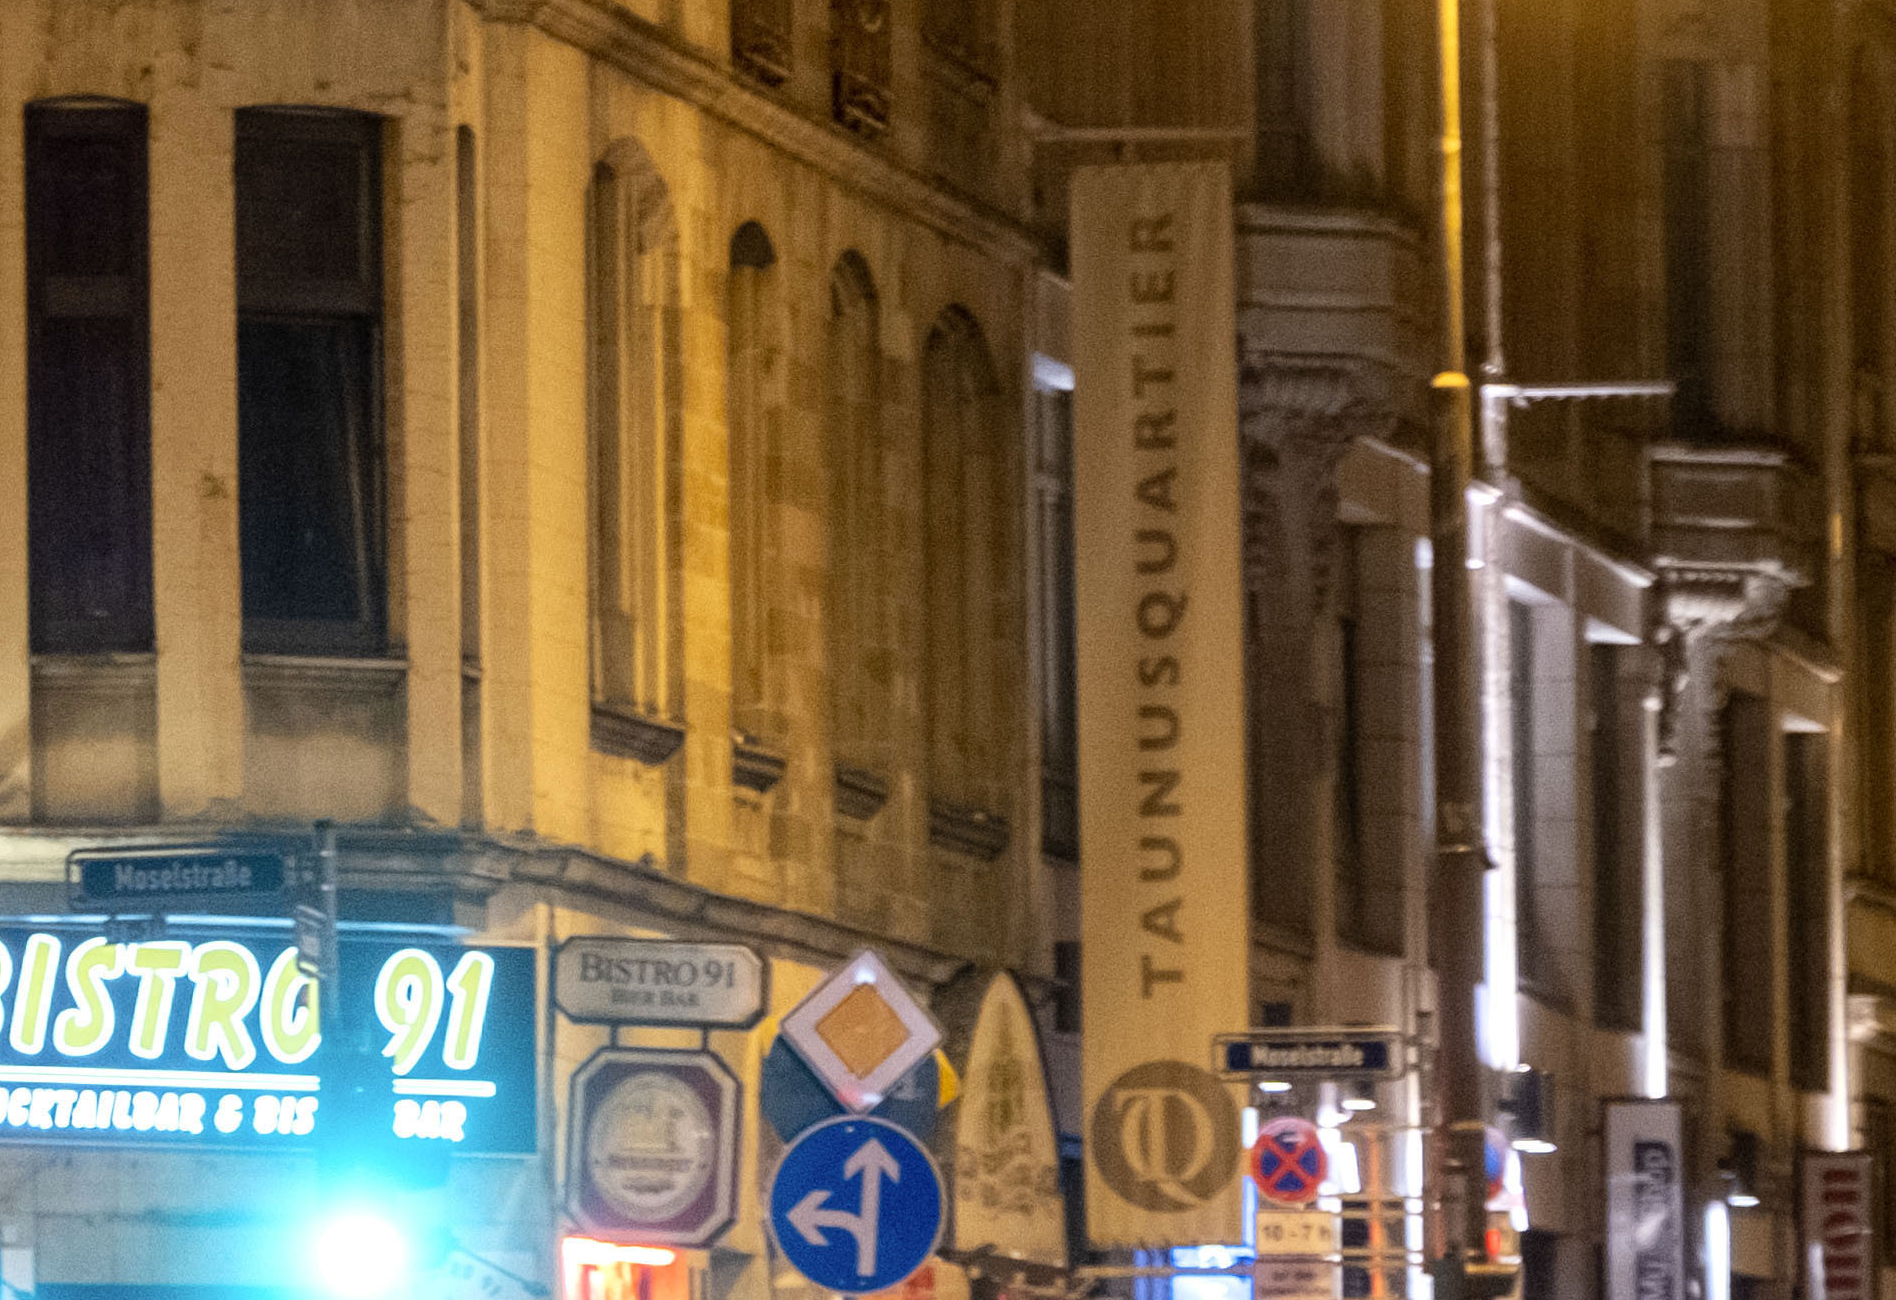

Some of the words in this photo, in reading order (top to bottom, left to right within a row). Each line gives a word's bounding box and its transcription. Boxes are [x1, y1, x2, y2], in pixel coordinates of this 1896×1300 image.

[1132, 210, 1187, 1001] TAUNUSQUARTIER
[113, 860, 253, 891] Moselstraße
[579, 952, 698, 986] BISTRO
[705, 958, 736, 988] 91
[374, 948, 496, 1075] 91
